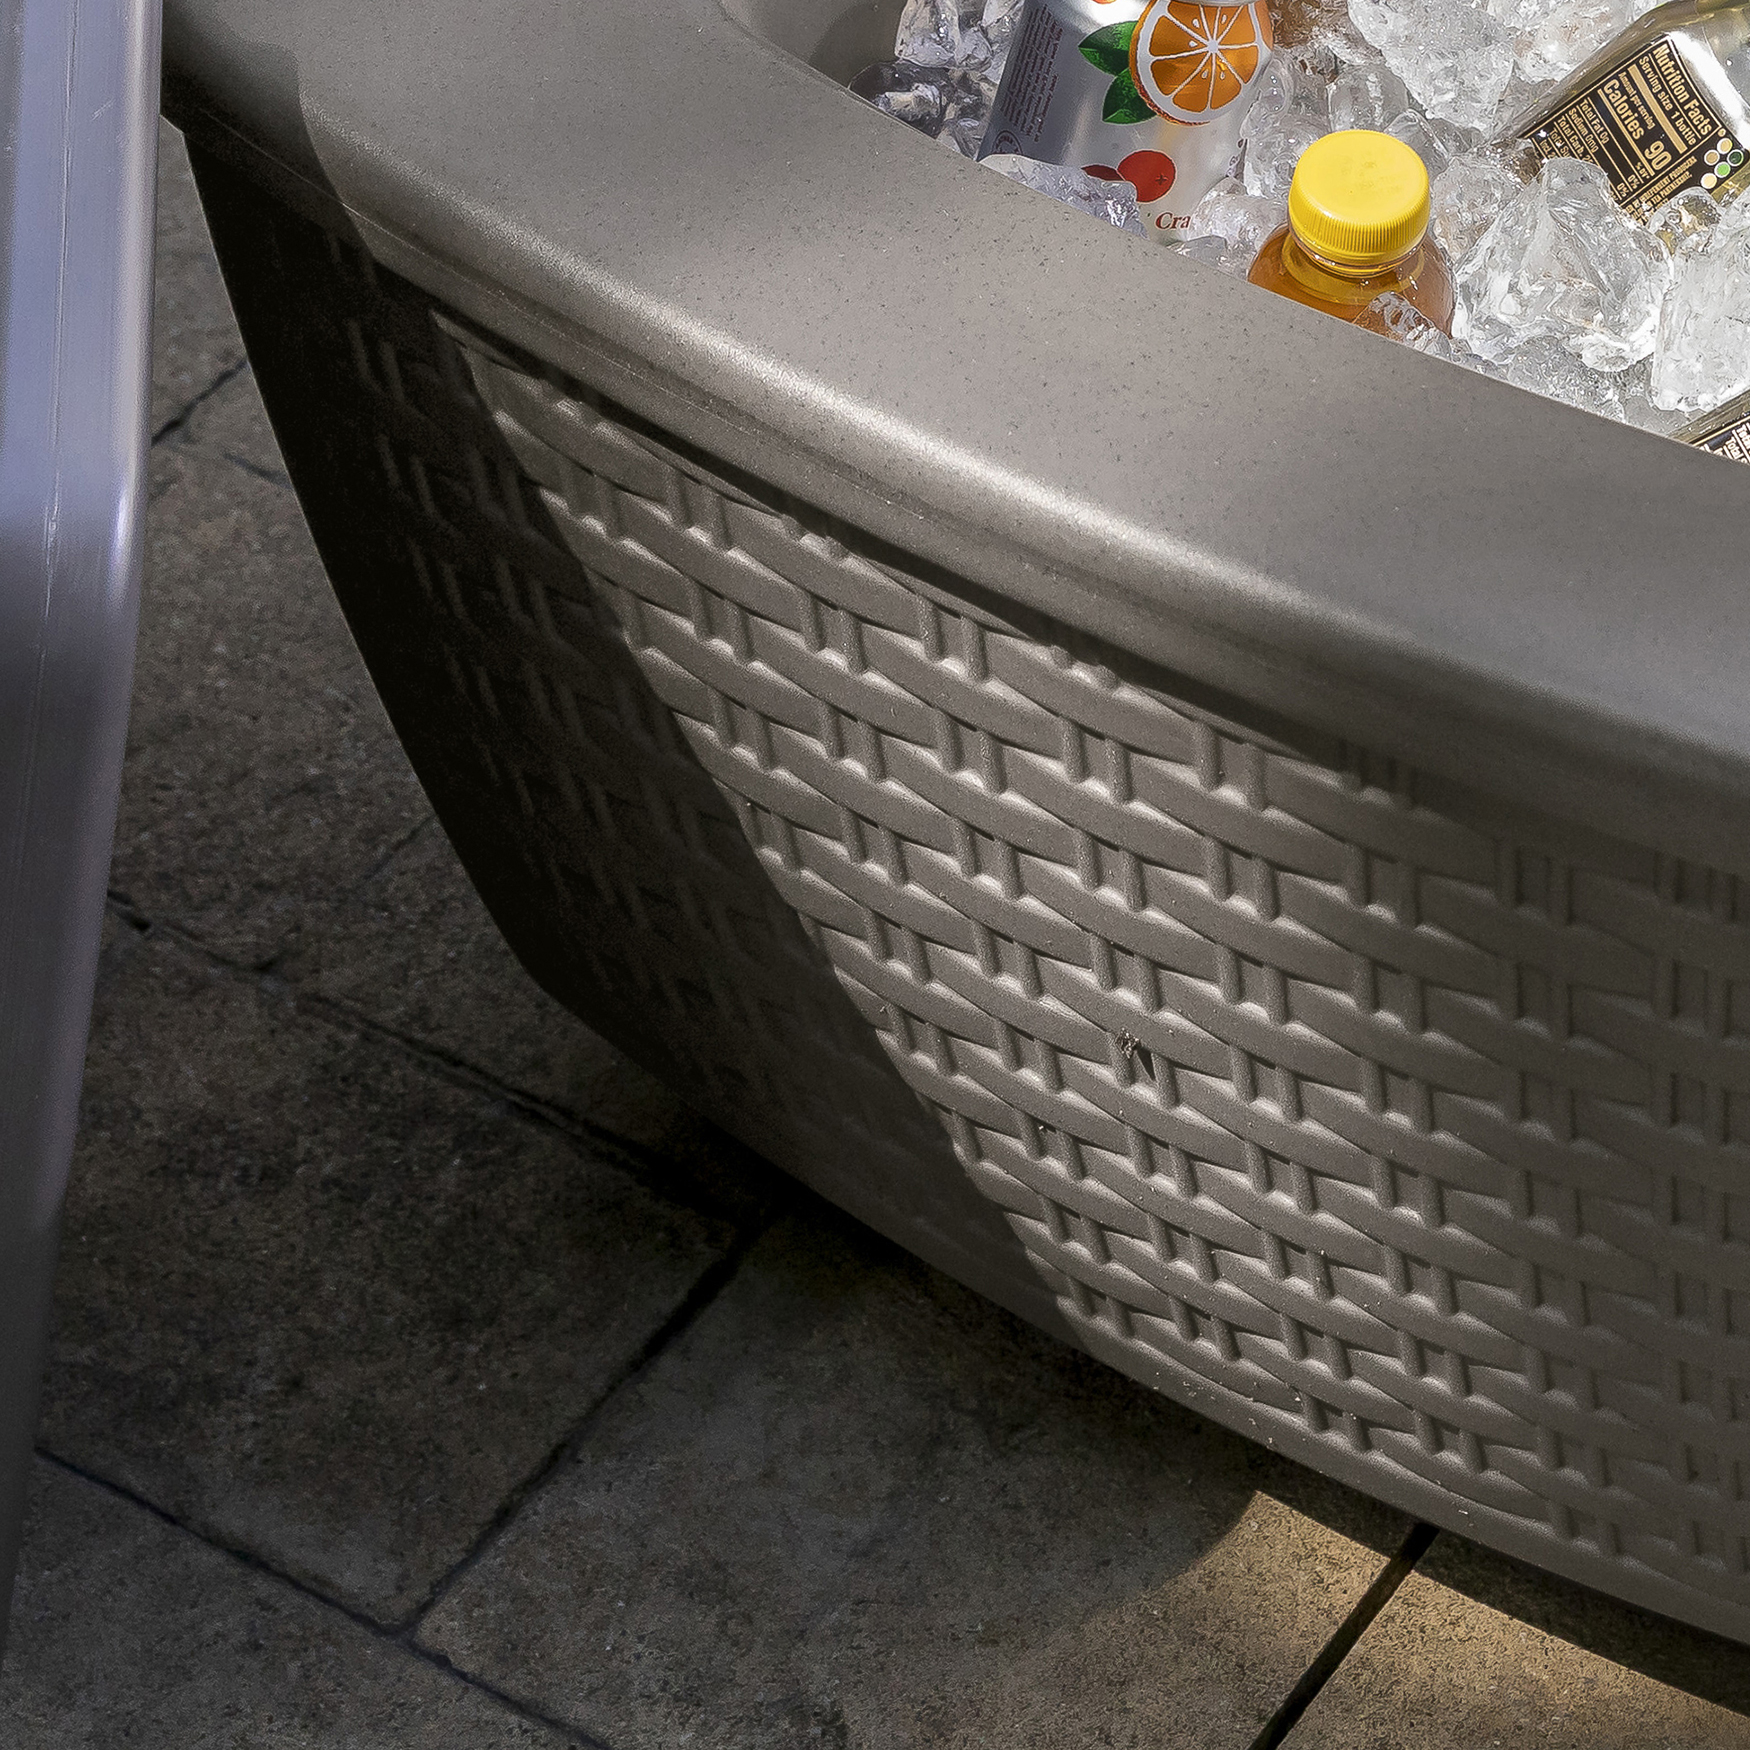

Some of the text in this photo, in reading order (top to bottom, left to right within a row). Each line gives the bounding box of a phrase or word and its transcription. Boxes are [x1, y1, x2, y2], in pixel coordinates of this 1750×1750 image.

[1557, 115, 1571, 138] Total
[1603, 78, 1672, 170] Calories 90
[1630, 94, 1642, 107] per
[1638, 105, 1655, 130] serving
[1639, 55, 1697, 146] Serving size 1 bottle
[1653, 43, 1712, 136] Nutrition Facts
[1568, 107, 1588, 136] Sodium
[1585, 133, 1599, 154] 0mg
[1617, 182, 1630, 198] 0%
[1579, 98, 1596, 122] Total
[1591, 119, 1605, 133] Fat
[1627, 174, 1640, 189] 0%
[1155, 212, 1191, 229] Cra
[1725, 437, 1742, 460] Total
